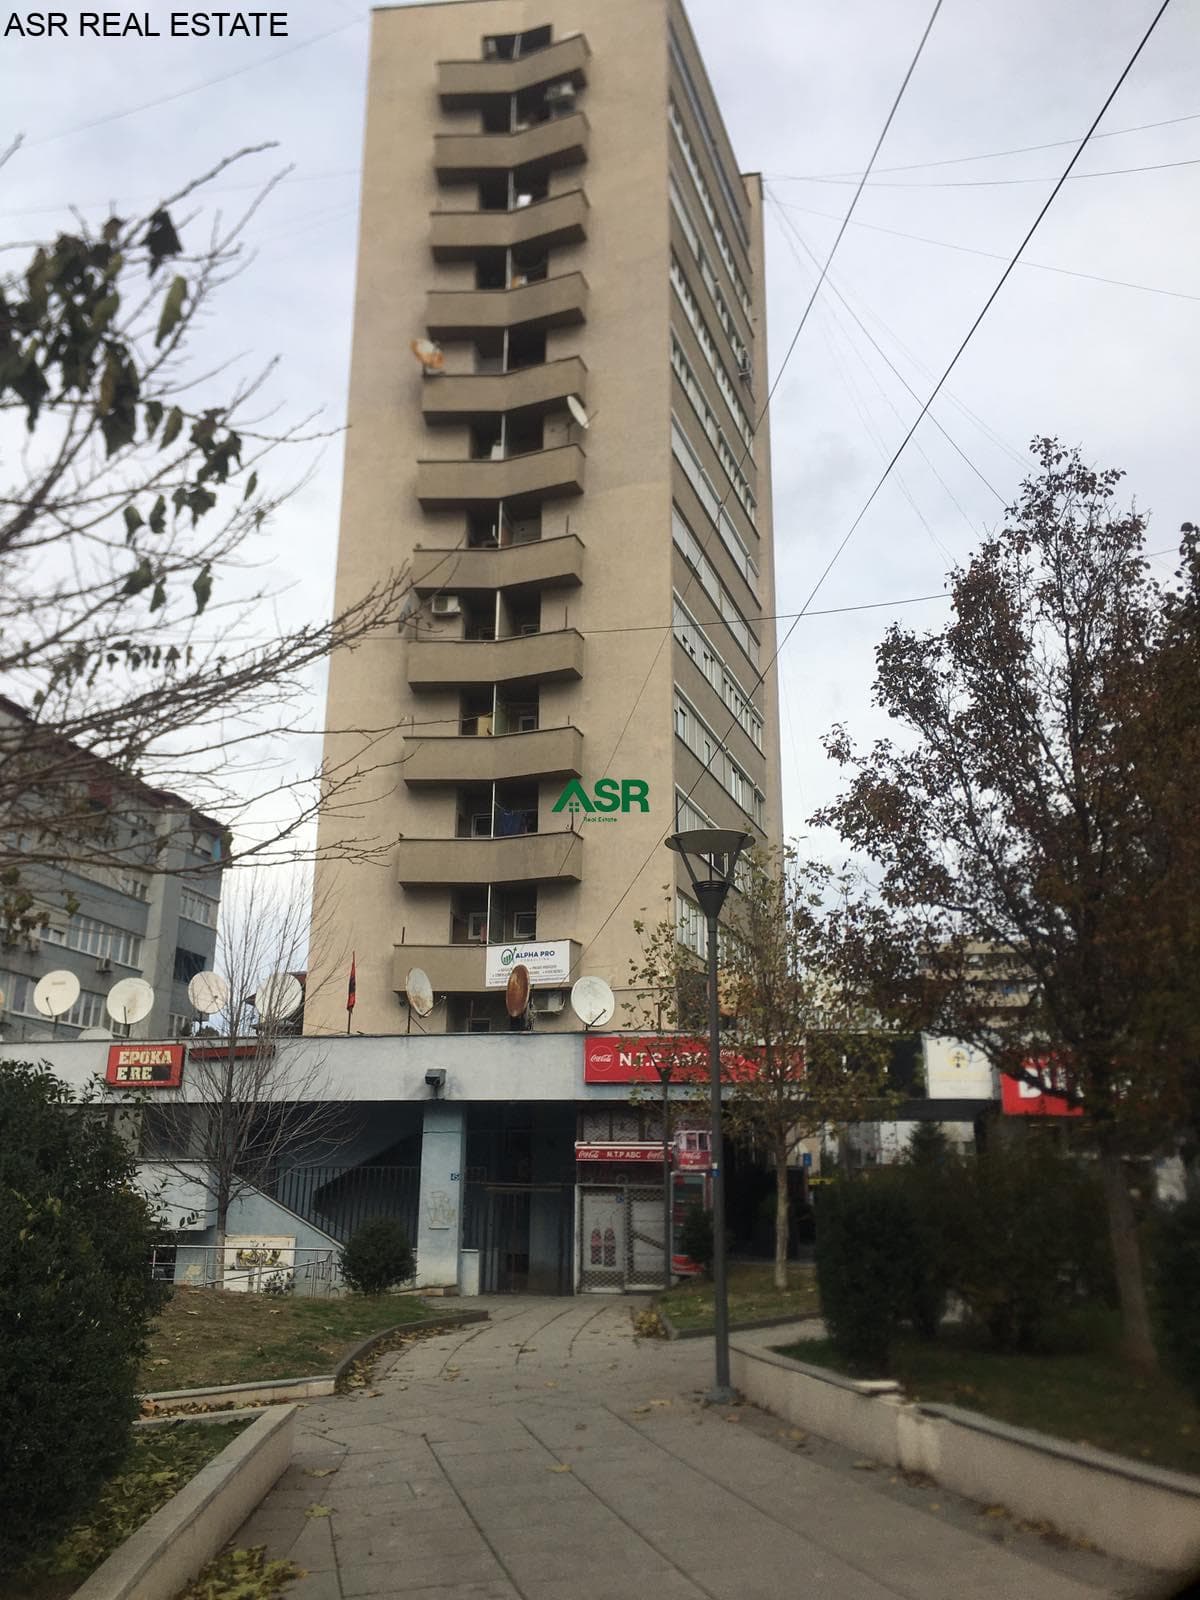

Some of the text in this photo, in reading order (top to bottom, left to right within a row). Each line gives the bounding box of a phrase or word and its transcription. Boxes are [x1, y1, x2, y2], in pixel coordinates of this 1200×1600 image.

[515, 951, 539, 959] ALPHA
[119, 1050, 172, 1064] EPOKA
[625, 1151, 641, 1159] ABC
